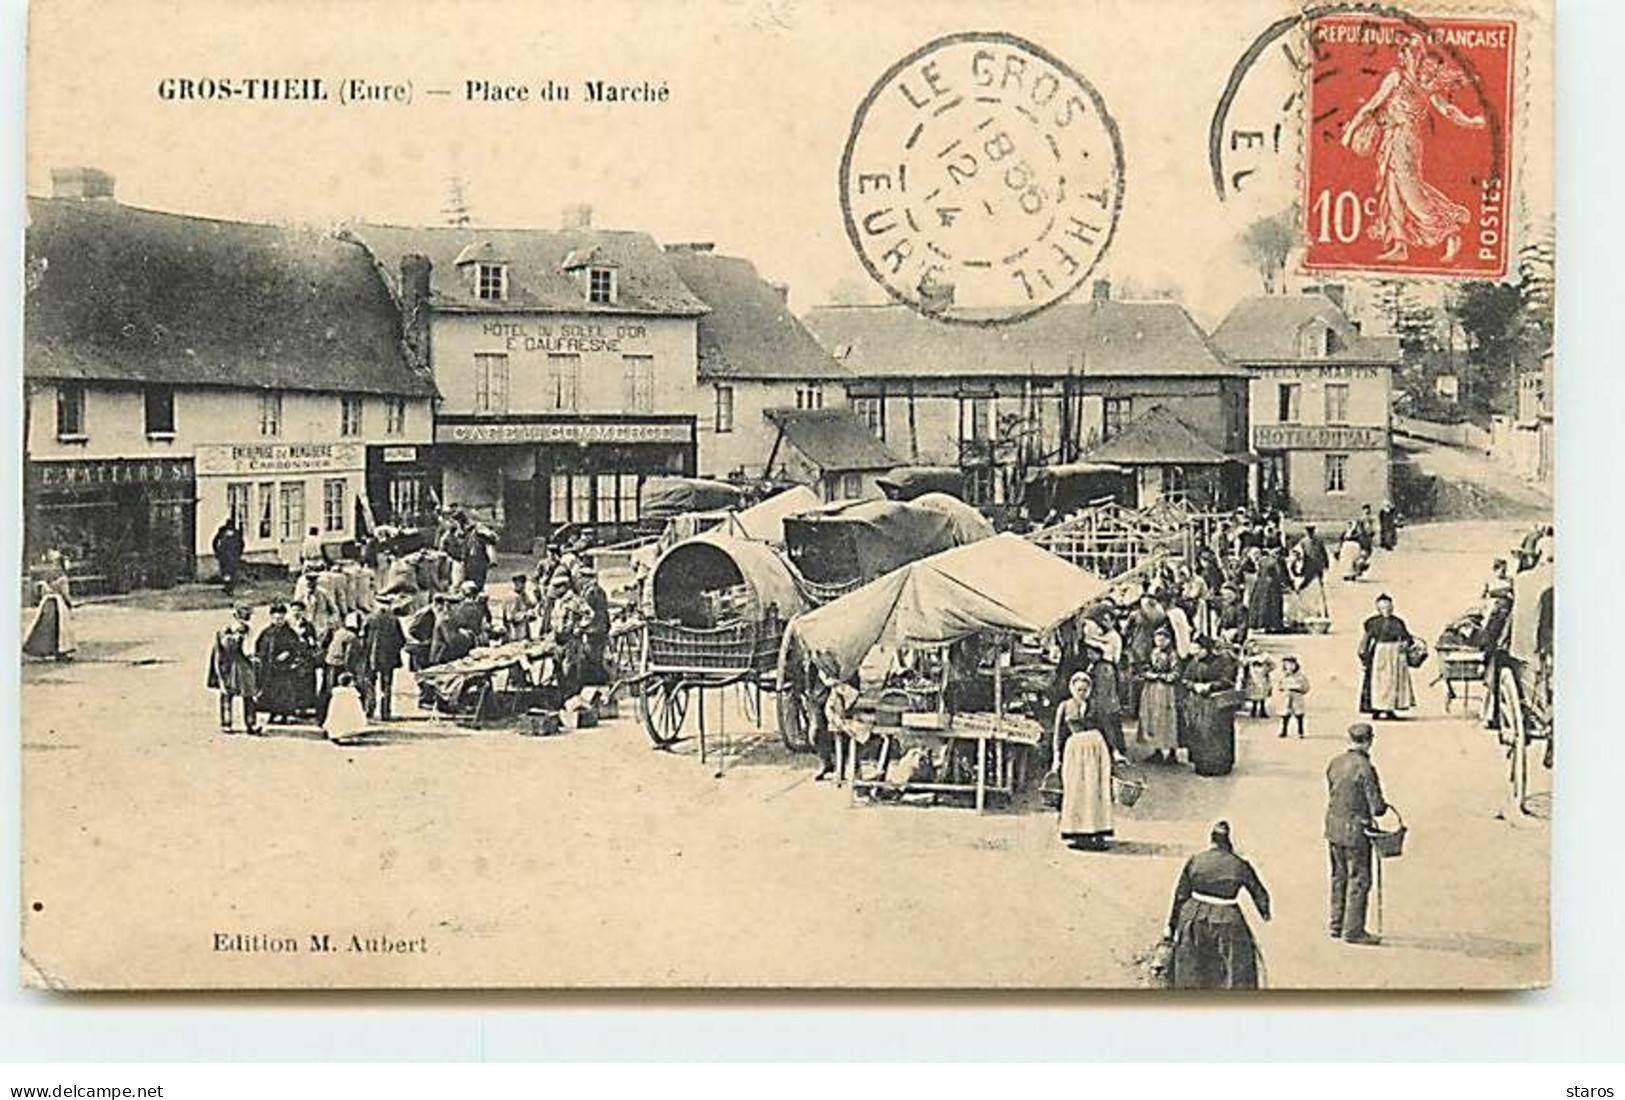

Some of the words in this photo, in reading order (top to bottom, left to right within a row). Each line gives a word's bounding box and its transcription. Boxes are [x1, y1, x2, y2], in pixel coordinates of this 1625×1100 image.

[158, 78, 328, 101] GROS-THEIL
[338, 77, 414, 105] (Eure)
[465, 79, 529, 101] Place
[540, 80, 571, 101] du
[584, 79, 670, 101] Marché
[900, 61, 951, 109] LE
[972, 50, 1085, 127] GROS
[1478, 180, 1502, 260] POSTES
[560, 325, 606, 337] SOLEIL
[550, 425, 672, 439] COMMERCE
[213, 933, 298, 952] Edition
[309, 934, 337, 952] M.
[348, 934, 428, 954] Aubert
